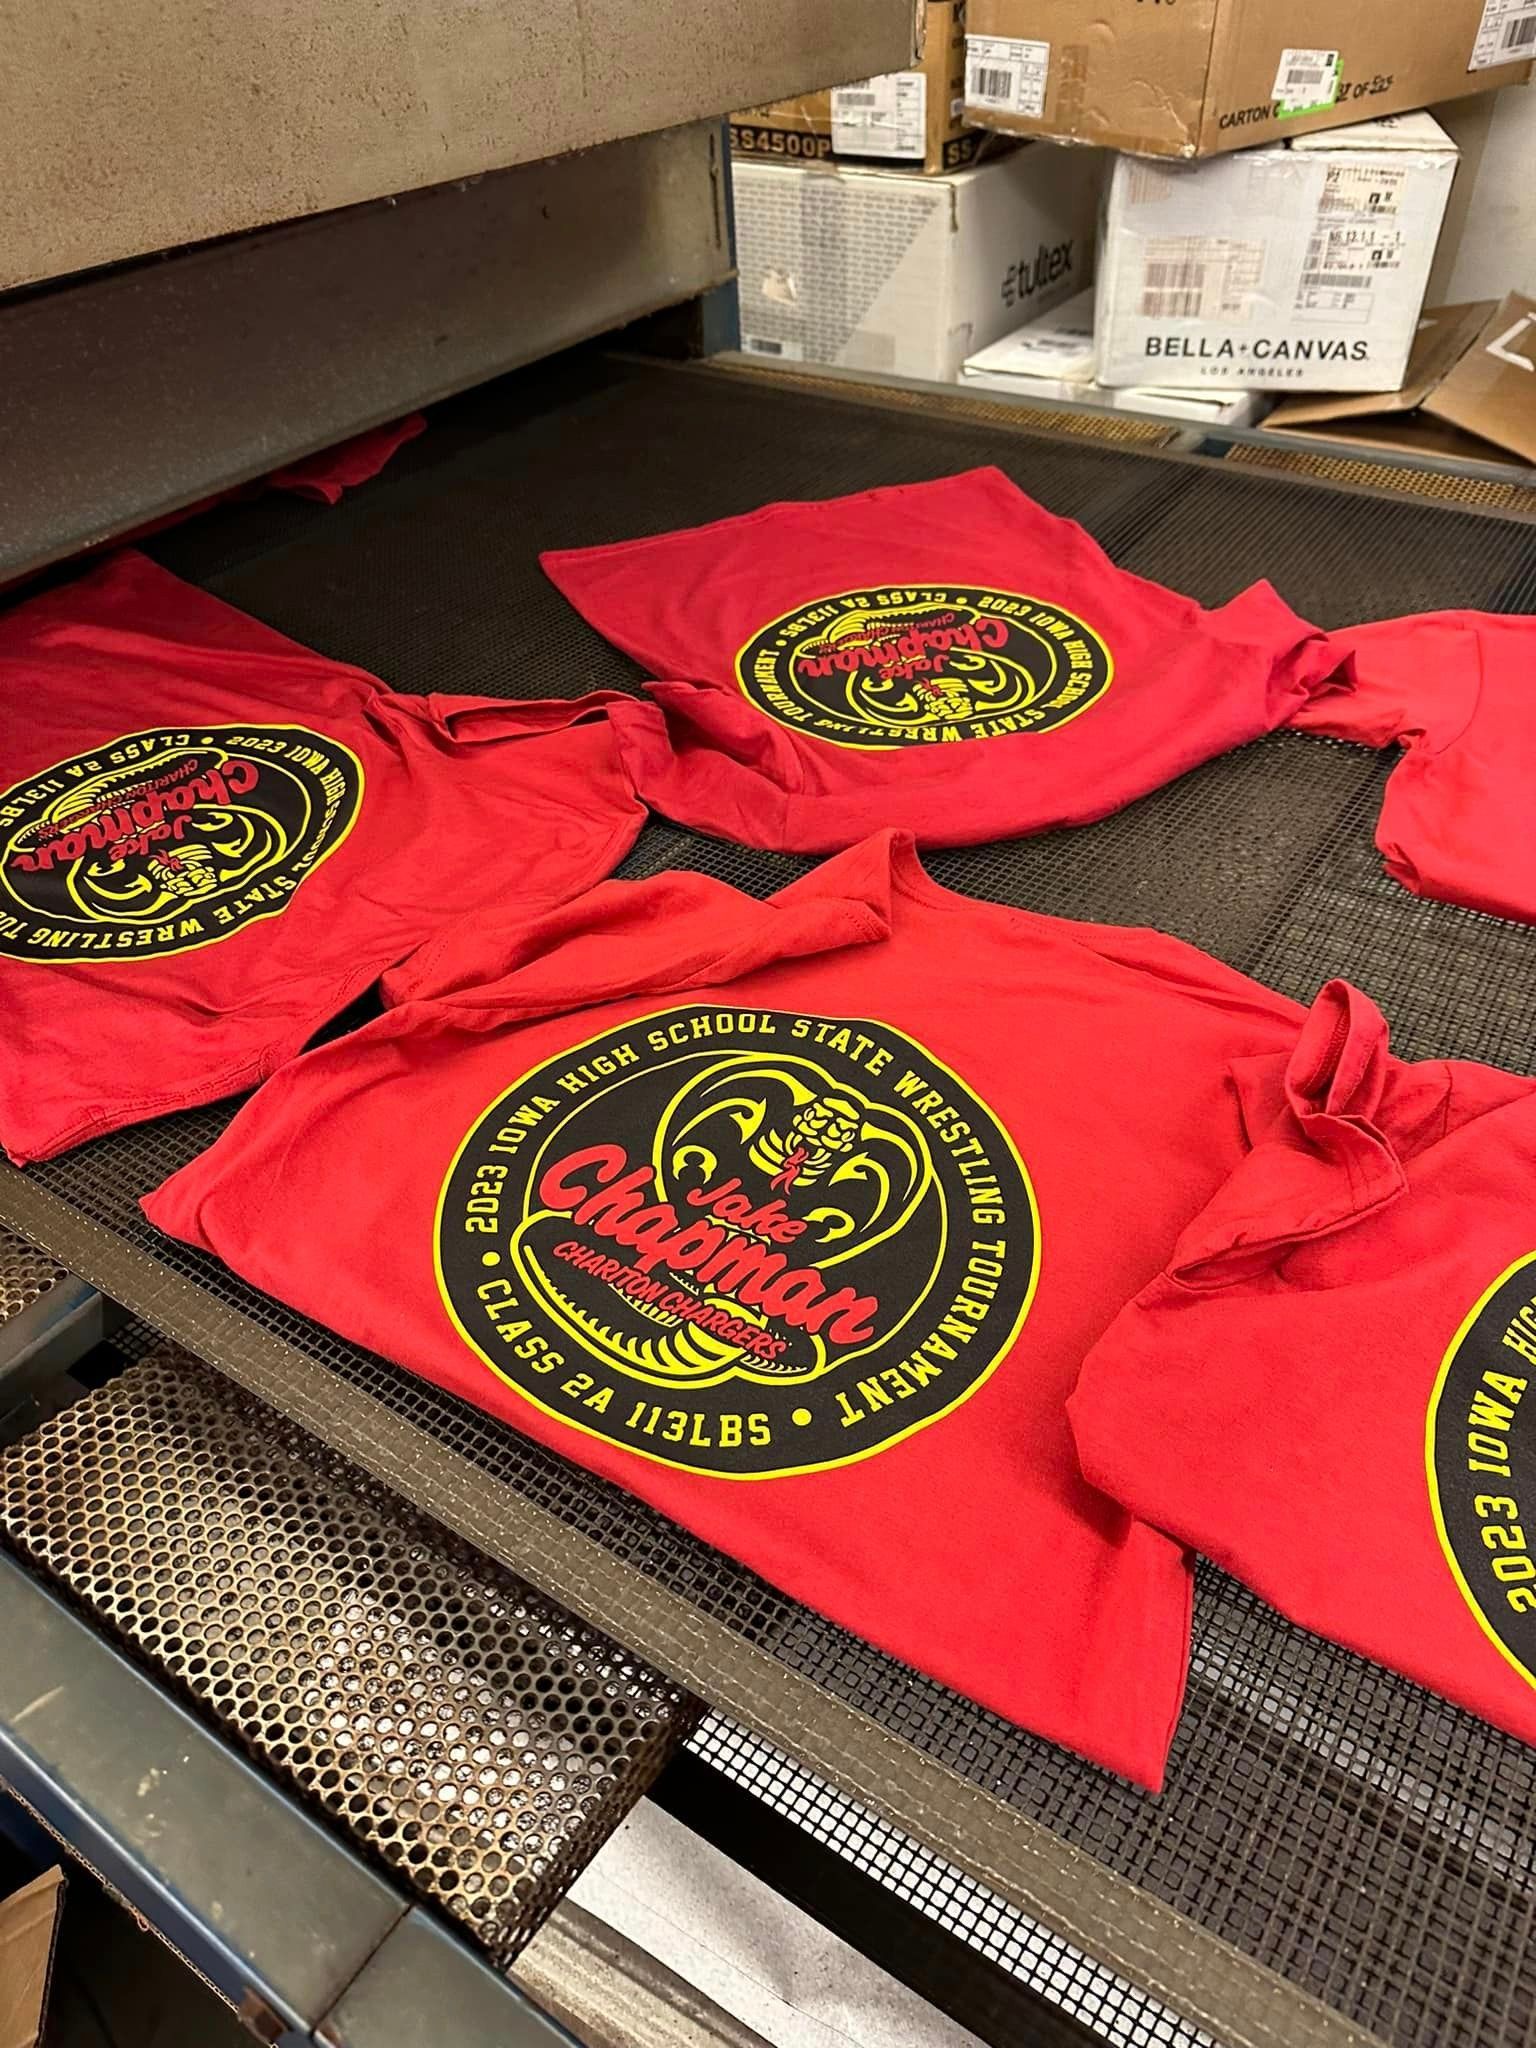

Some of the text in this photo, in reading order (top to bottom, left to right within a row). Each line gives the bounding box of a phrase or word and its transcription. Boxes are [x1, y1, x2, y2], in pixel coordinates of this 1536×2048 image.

[1219, 104, 1271, 129] CARTON
[1353, 81, 1370, 99] OF
[1017, 239, 1073, 298] tultex
[1200, 367, 1304, 378] LOS ANGELES
[779, 592, 947, 637] CLASS 2A 113LBS
[1029, 612, 1075, 640] IOWA
[798, 618, 1009, 678] Chapman
[879, 654, 949, 681] Jake
[225, 735, 287, 753] 2023
[970, 708, 1046, 739] STATE
[65, 760, 102, 778] 2A
[110, 734, 190, 764] CLASS
[284, 745, 330, 775] IOWA
[11, 760, 259, 872] Chapman
[110, 814, 193, 861] Jake
[212, 875, 297, 925] STATE
[27, 917, 205, 949] WRESTLING
[465, 1013, 1007, 1428] 2023 IOWA HIGH SCHOOL STATE WRESTLING TOURNAMENT
[686, 1177, 808, 1243] Jake
[539, 1144, 878, 1345] Chapman
[553, 1241, 787, 1360] CHARITON CHARGERS
[476, 1278, 772, 1447] CLASS 2A 113LBS
[1468, 1370, 1528, 1478] IOWA
[1474, 1494, 1536, 1613] 2023
